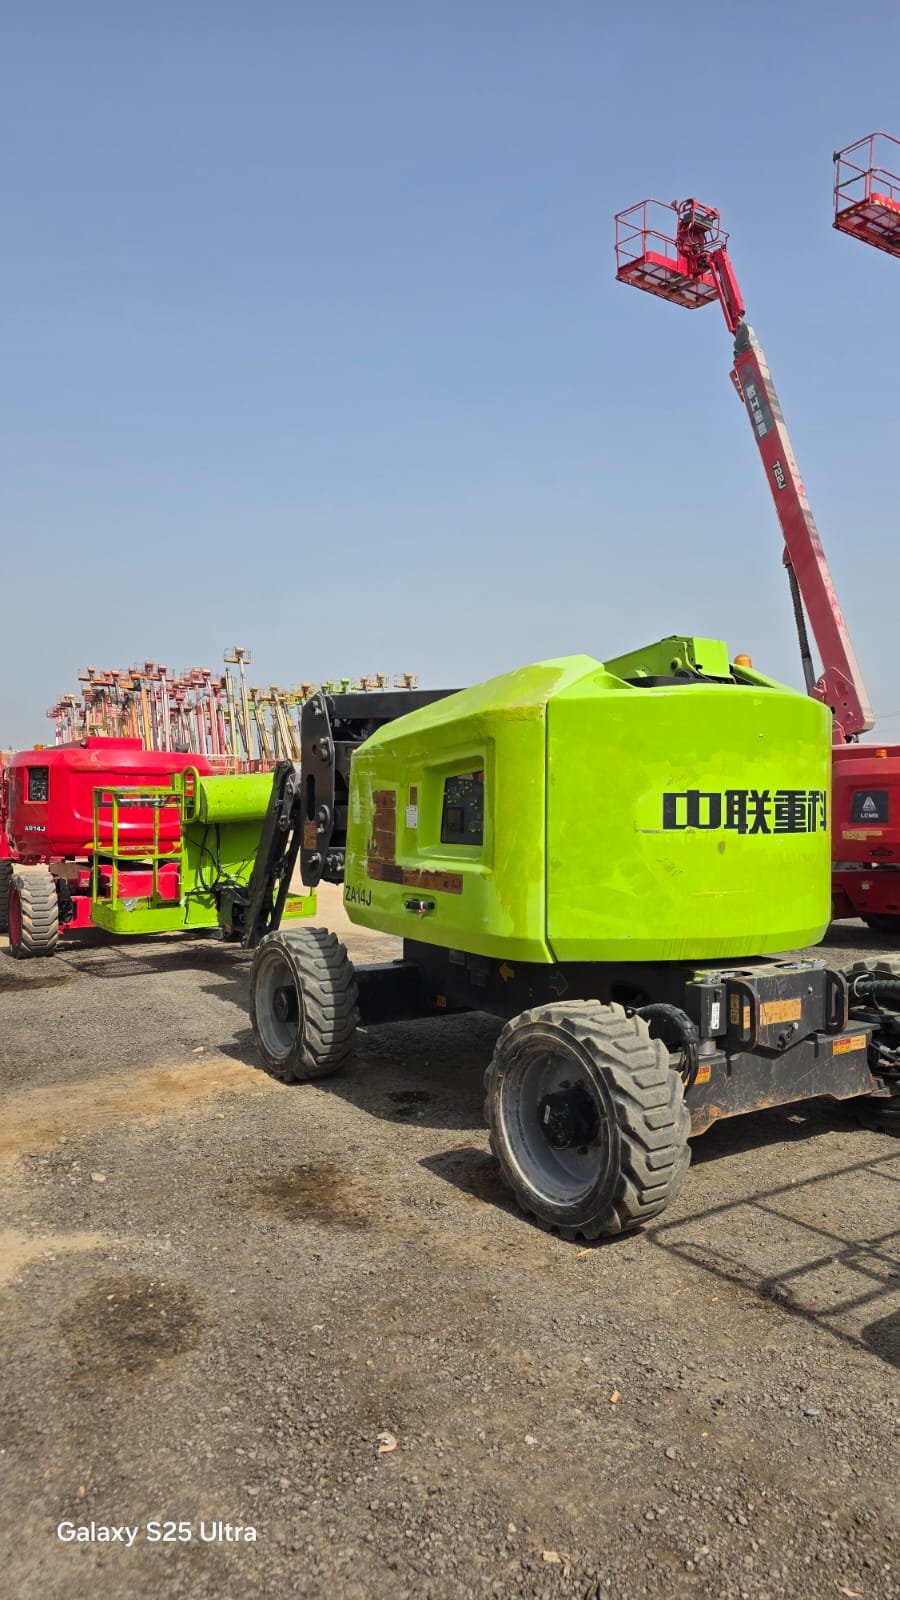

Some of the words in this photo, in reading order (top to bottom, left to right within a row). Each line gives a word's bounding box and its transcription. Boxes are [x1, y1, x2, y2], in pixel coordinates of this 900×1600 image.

[772, 460, 787, 490] T22J
[662, 789, 827, 835] 中联重科
[344, 885, 372, 907] ZA14J
